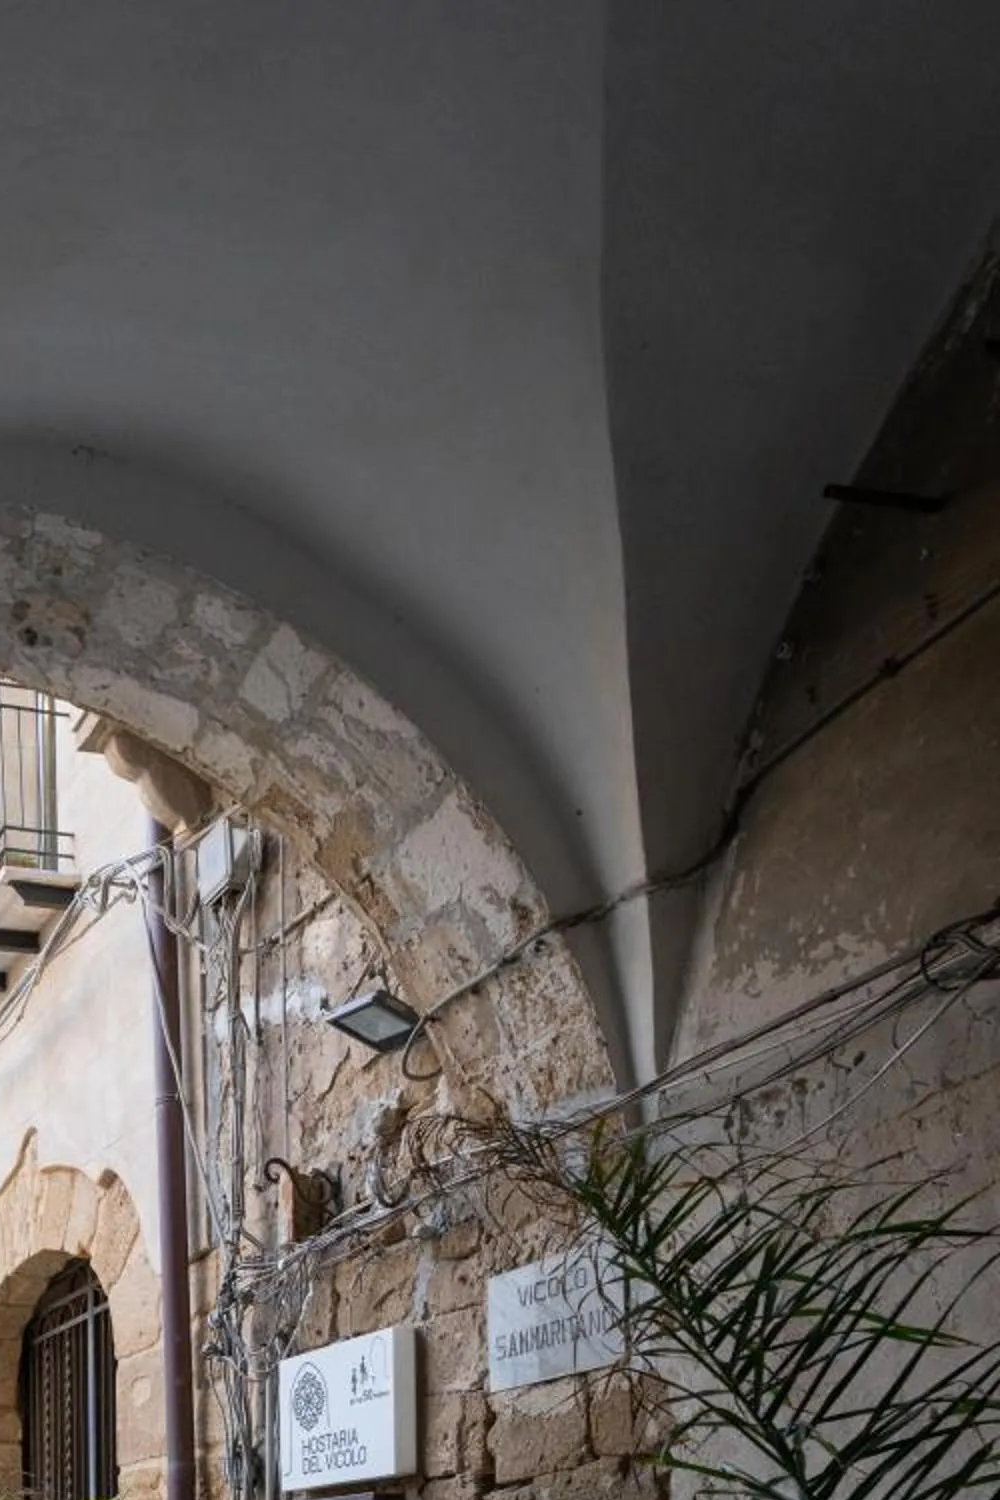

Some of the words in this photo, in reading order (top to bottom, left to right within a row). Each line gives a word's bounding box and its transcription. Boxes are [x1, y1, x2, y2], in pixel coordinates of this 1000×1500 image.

[517, 1267, 587, 1306] VICOLO
[301, 1428, 358, 1454] HOSTARIA
[301, 1456, 322, 1475] DEL
[324, 1445, 367, 1469] VICOLO
